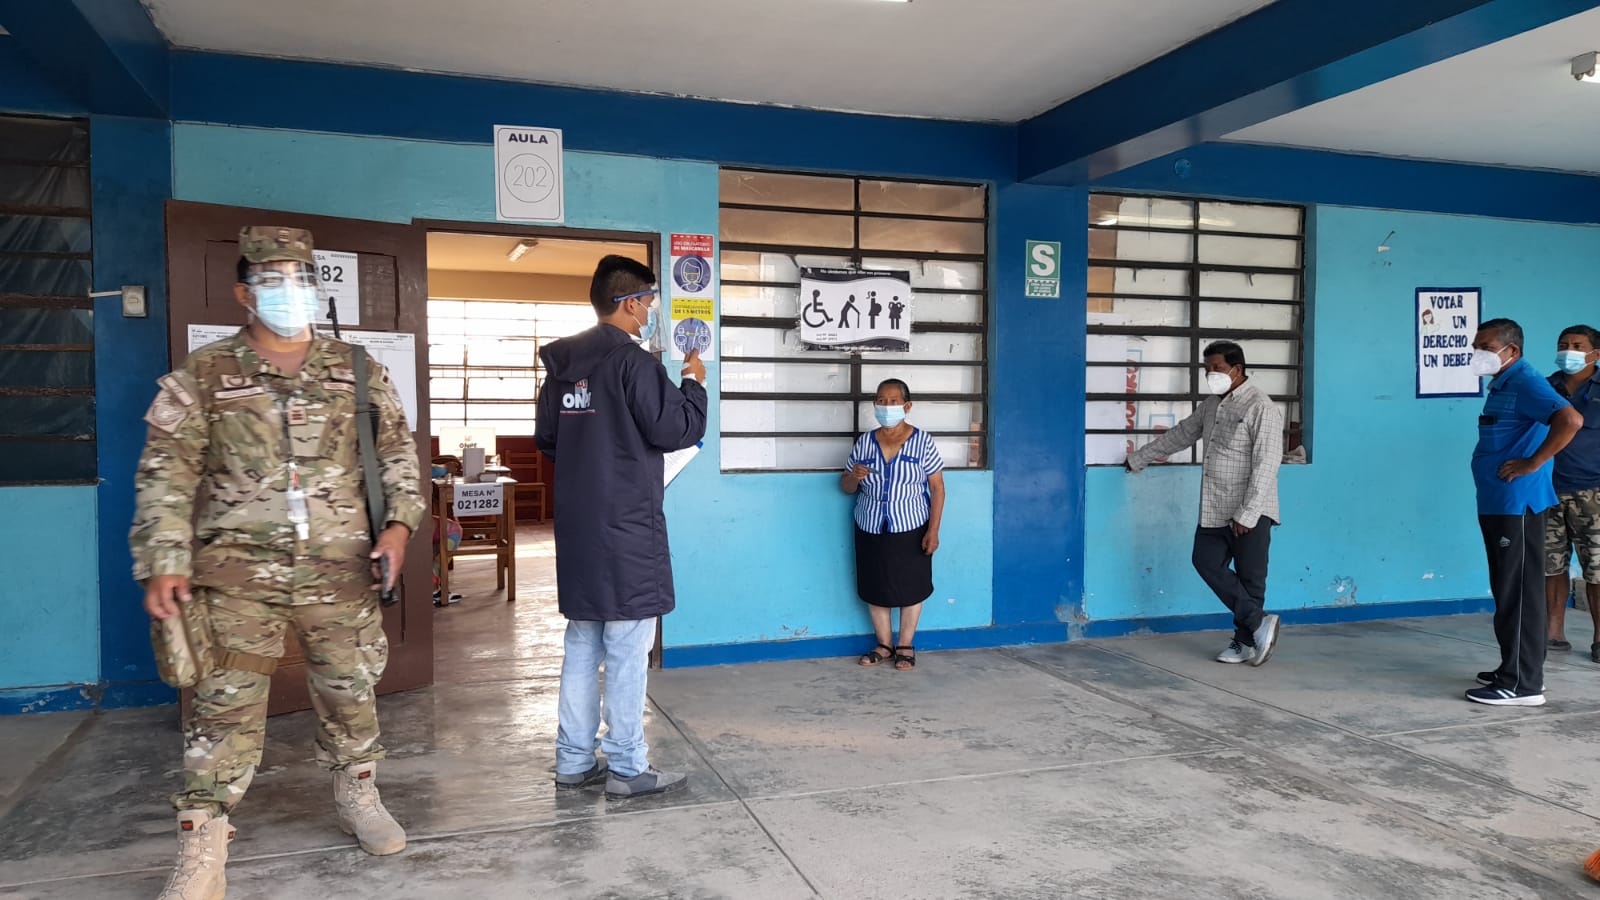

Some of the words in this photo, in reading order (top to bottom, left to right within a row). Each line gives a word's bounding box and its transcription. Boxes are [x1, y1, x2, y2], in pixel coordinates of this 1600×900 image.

[508, 132, 549, 145] AULA
[513, 164, 548, 188] 202
[1031, 244, 1056, 276] S
[1430, 295, 1463, 309] VOTAR
[1453, 315, 1467, 329] UN
[1423, 334, 1468, 349] DERECHO
[1423, 354, 1438, 368] UN
[457, 498, 500, 510] 021282
